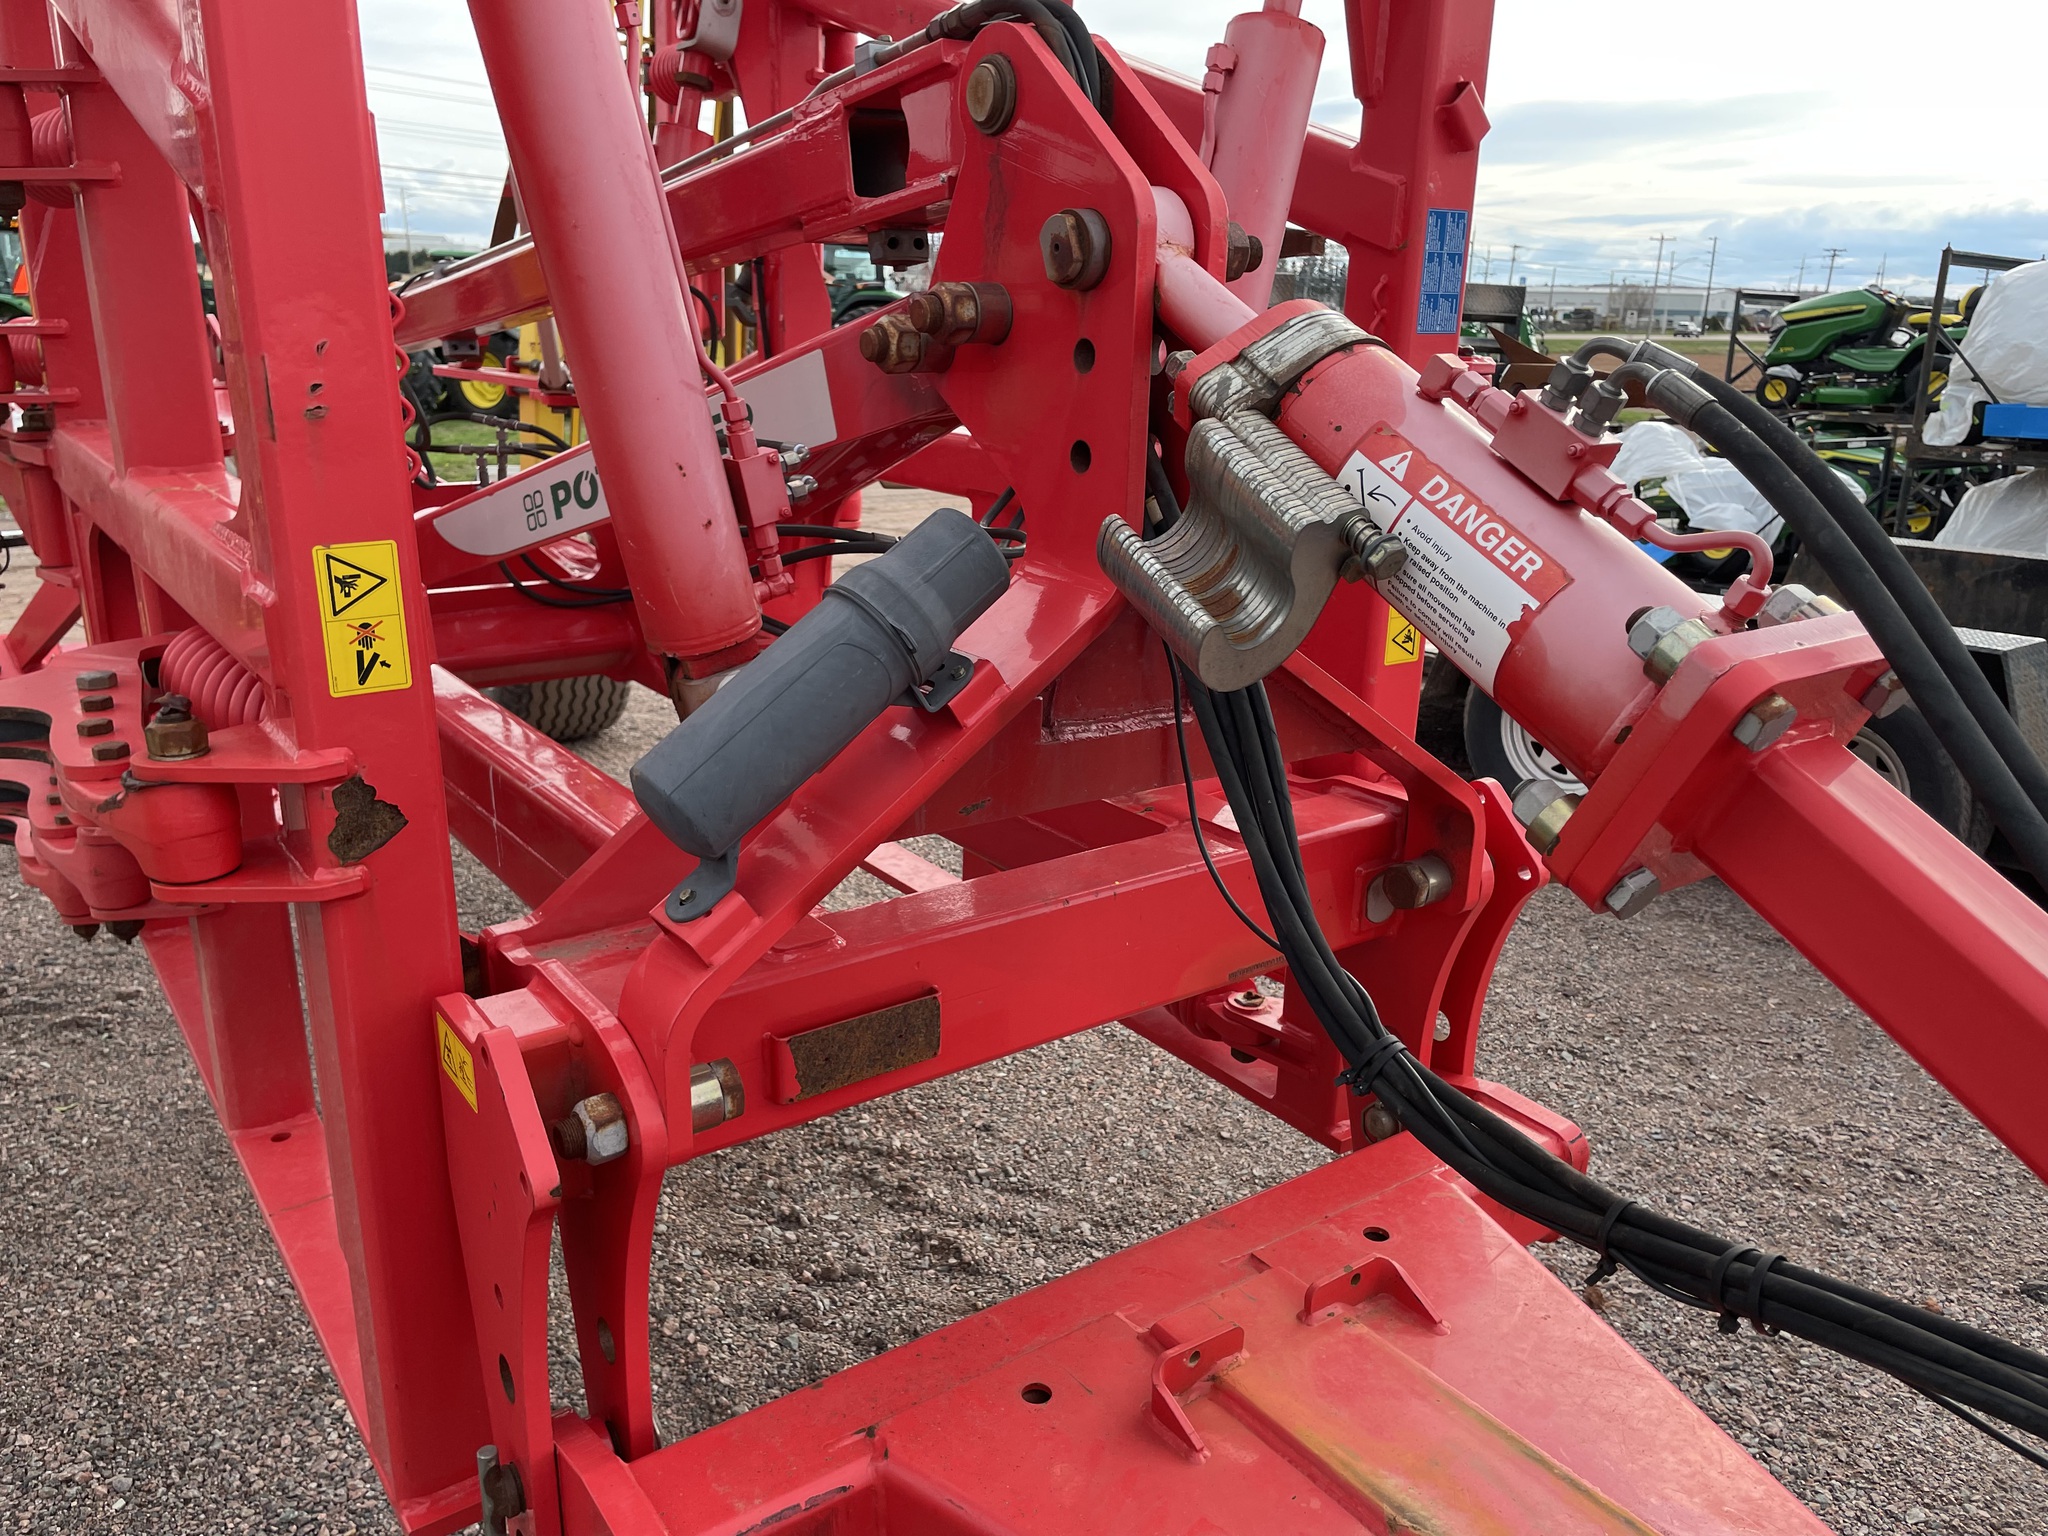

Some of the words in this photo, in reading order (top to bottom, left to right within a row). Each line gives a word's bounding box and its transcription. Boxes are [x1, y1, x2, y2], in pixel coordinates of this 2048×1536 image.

[550, 466, 599, 520] PÖ
[1411, 525, 1433, 544] Avoid
[1431, 540, 1453, 562] injury
[1418, 474, 1544, 582] DANGER
[1393, 574, 1416, 595] topped
[1417, 592, 1437, 614] before
[1438, 613, 1469, 643] servicing
[1402, 570, 1417, 585] sure
[1418, 583, 1427, 593] all
[1427, 591, 1462, 624] movement
[1463, 621, 1476, 636] has
[1403, 537, 1421, 555] Keep
[1421, 554, 1439, 571] away
[1439, 568, 1456, 585] from
[1456, 583, 1468, 596] the
[1468, 594, 1498, 622] machine
[1498, 619, 1506, 629] in
[1409, 558, 1431, 578] raised
[1430, 577, 1459, 603] position
[1388, 580, 1409, 602] Failure
[1410, 600, 1417, 609] to
[1418, 608, 1441, 631] comply
[1442, 630, 1454, 642] will
[1455, 642, 1474, 661] result
[1475, 659, 1482, 668] in
[1414, 613, 1437, 636] serious
[1439, 634, 1457, 654] injury
